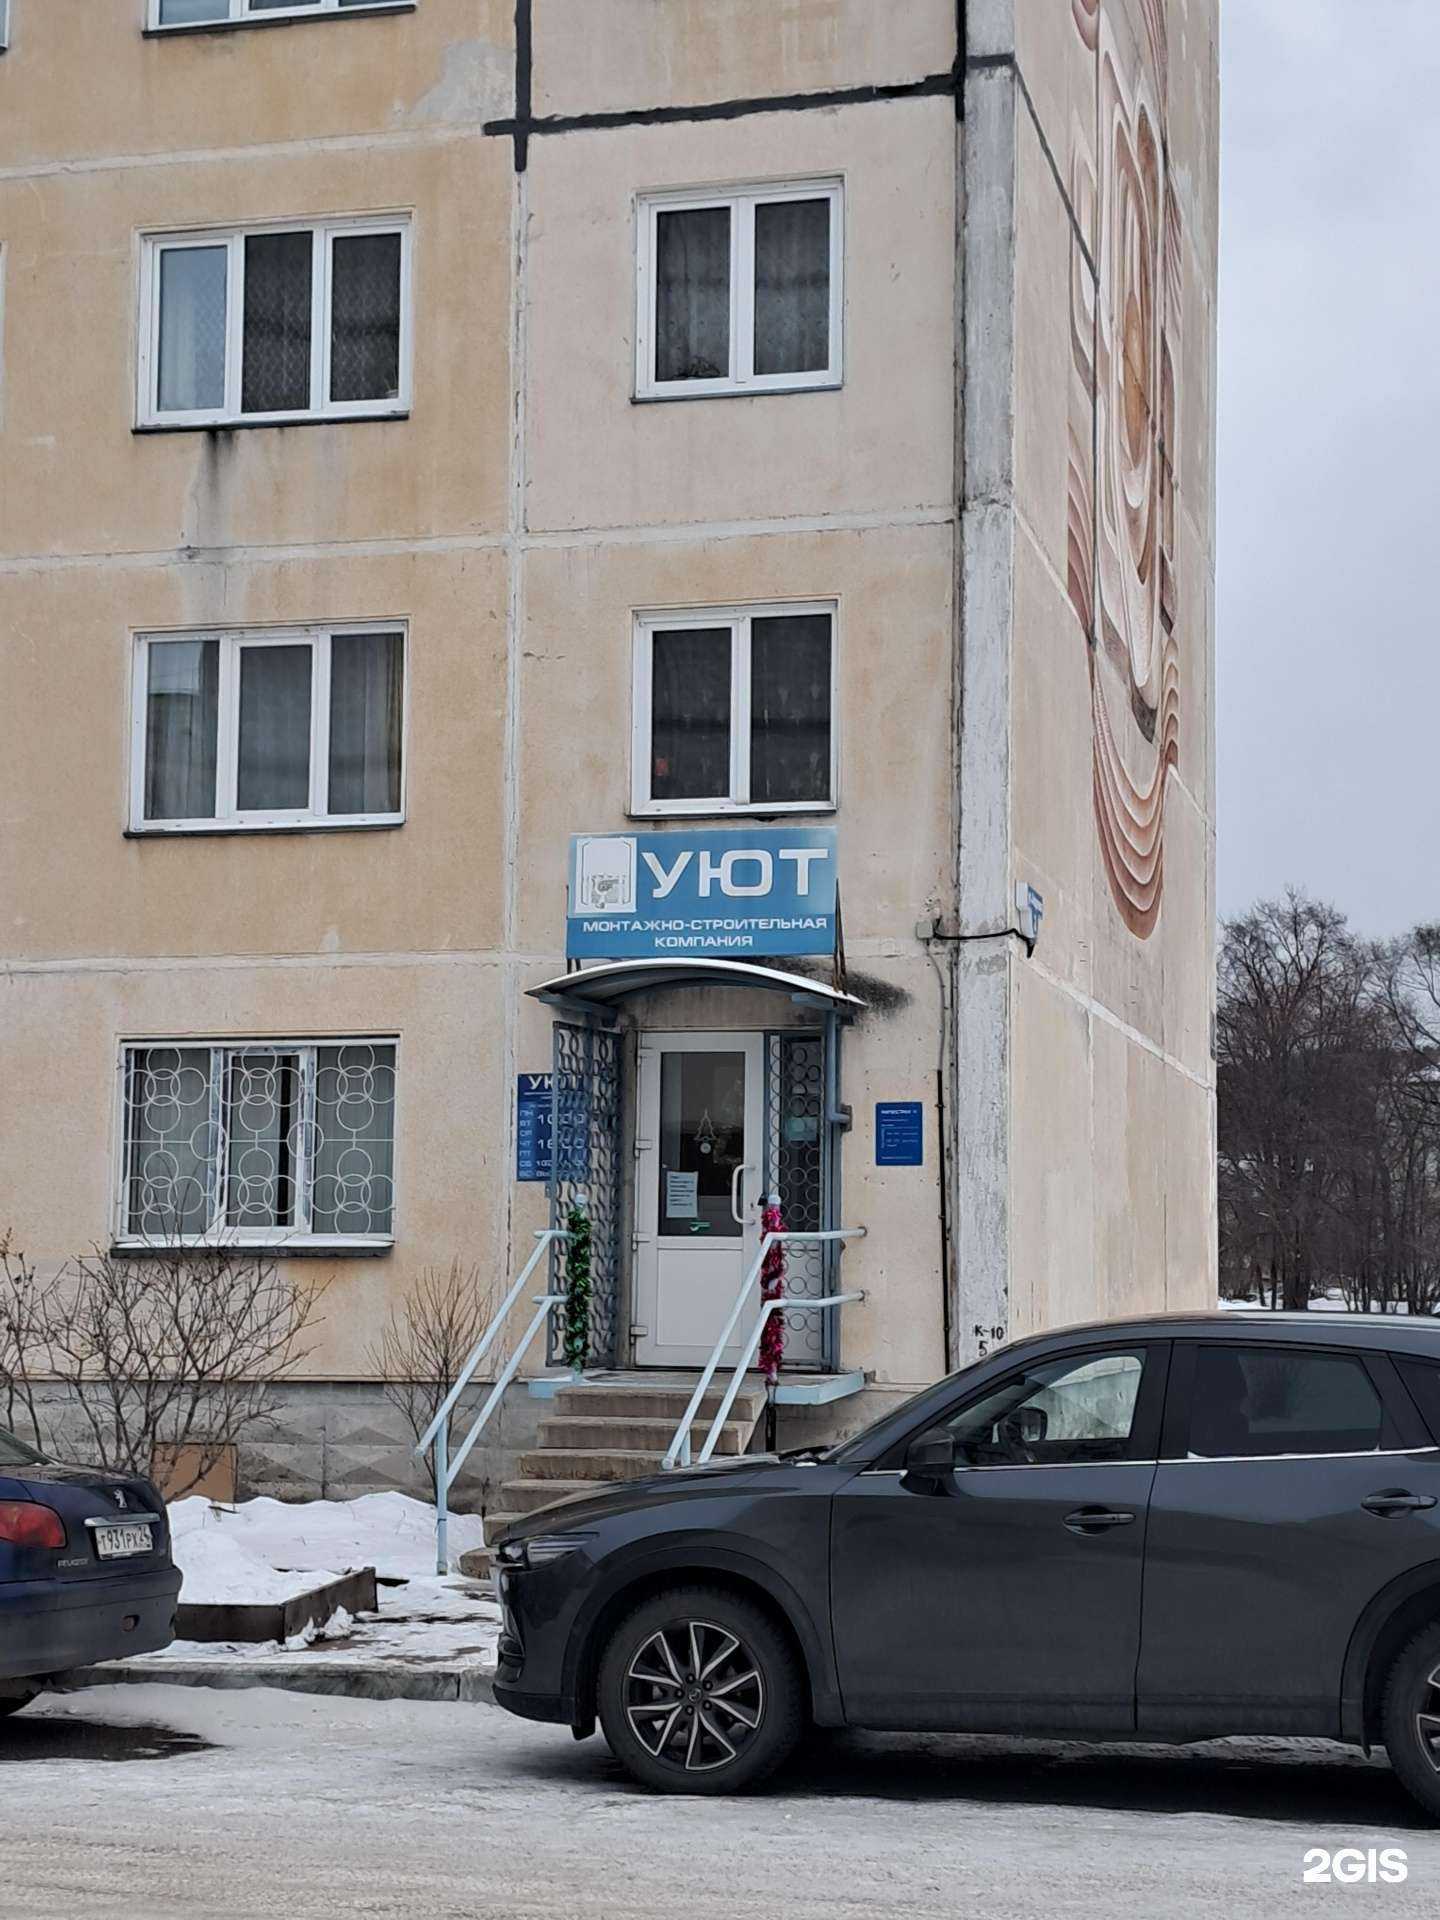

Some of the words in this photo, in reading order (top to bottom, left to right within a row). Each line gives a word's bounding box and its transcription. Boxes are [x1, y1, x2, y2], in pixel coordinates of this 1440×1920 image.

[641, 849, 829, 898] УЮТ
[583, 917, 827, 933] МОНТАЖНО-СТРОИТЕЛЬНАЯ
[654, 935, 753, 949] КОМПАНИЯ
